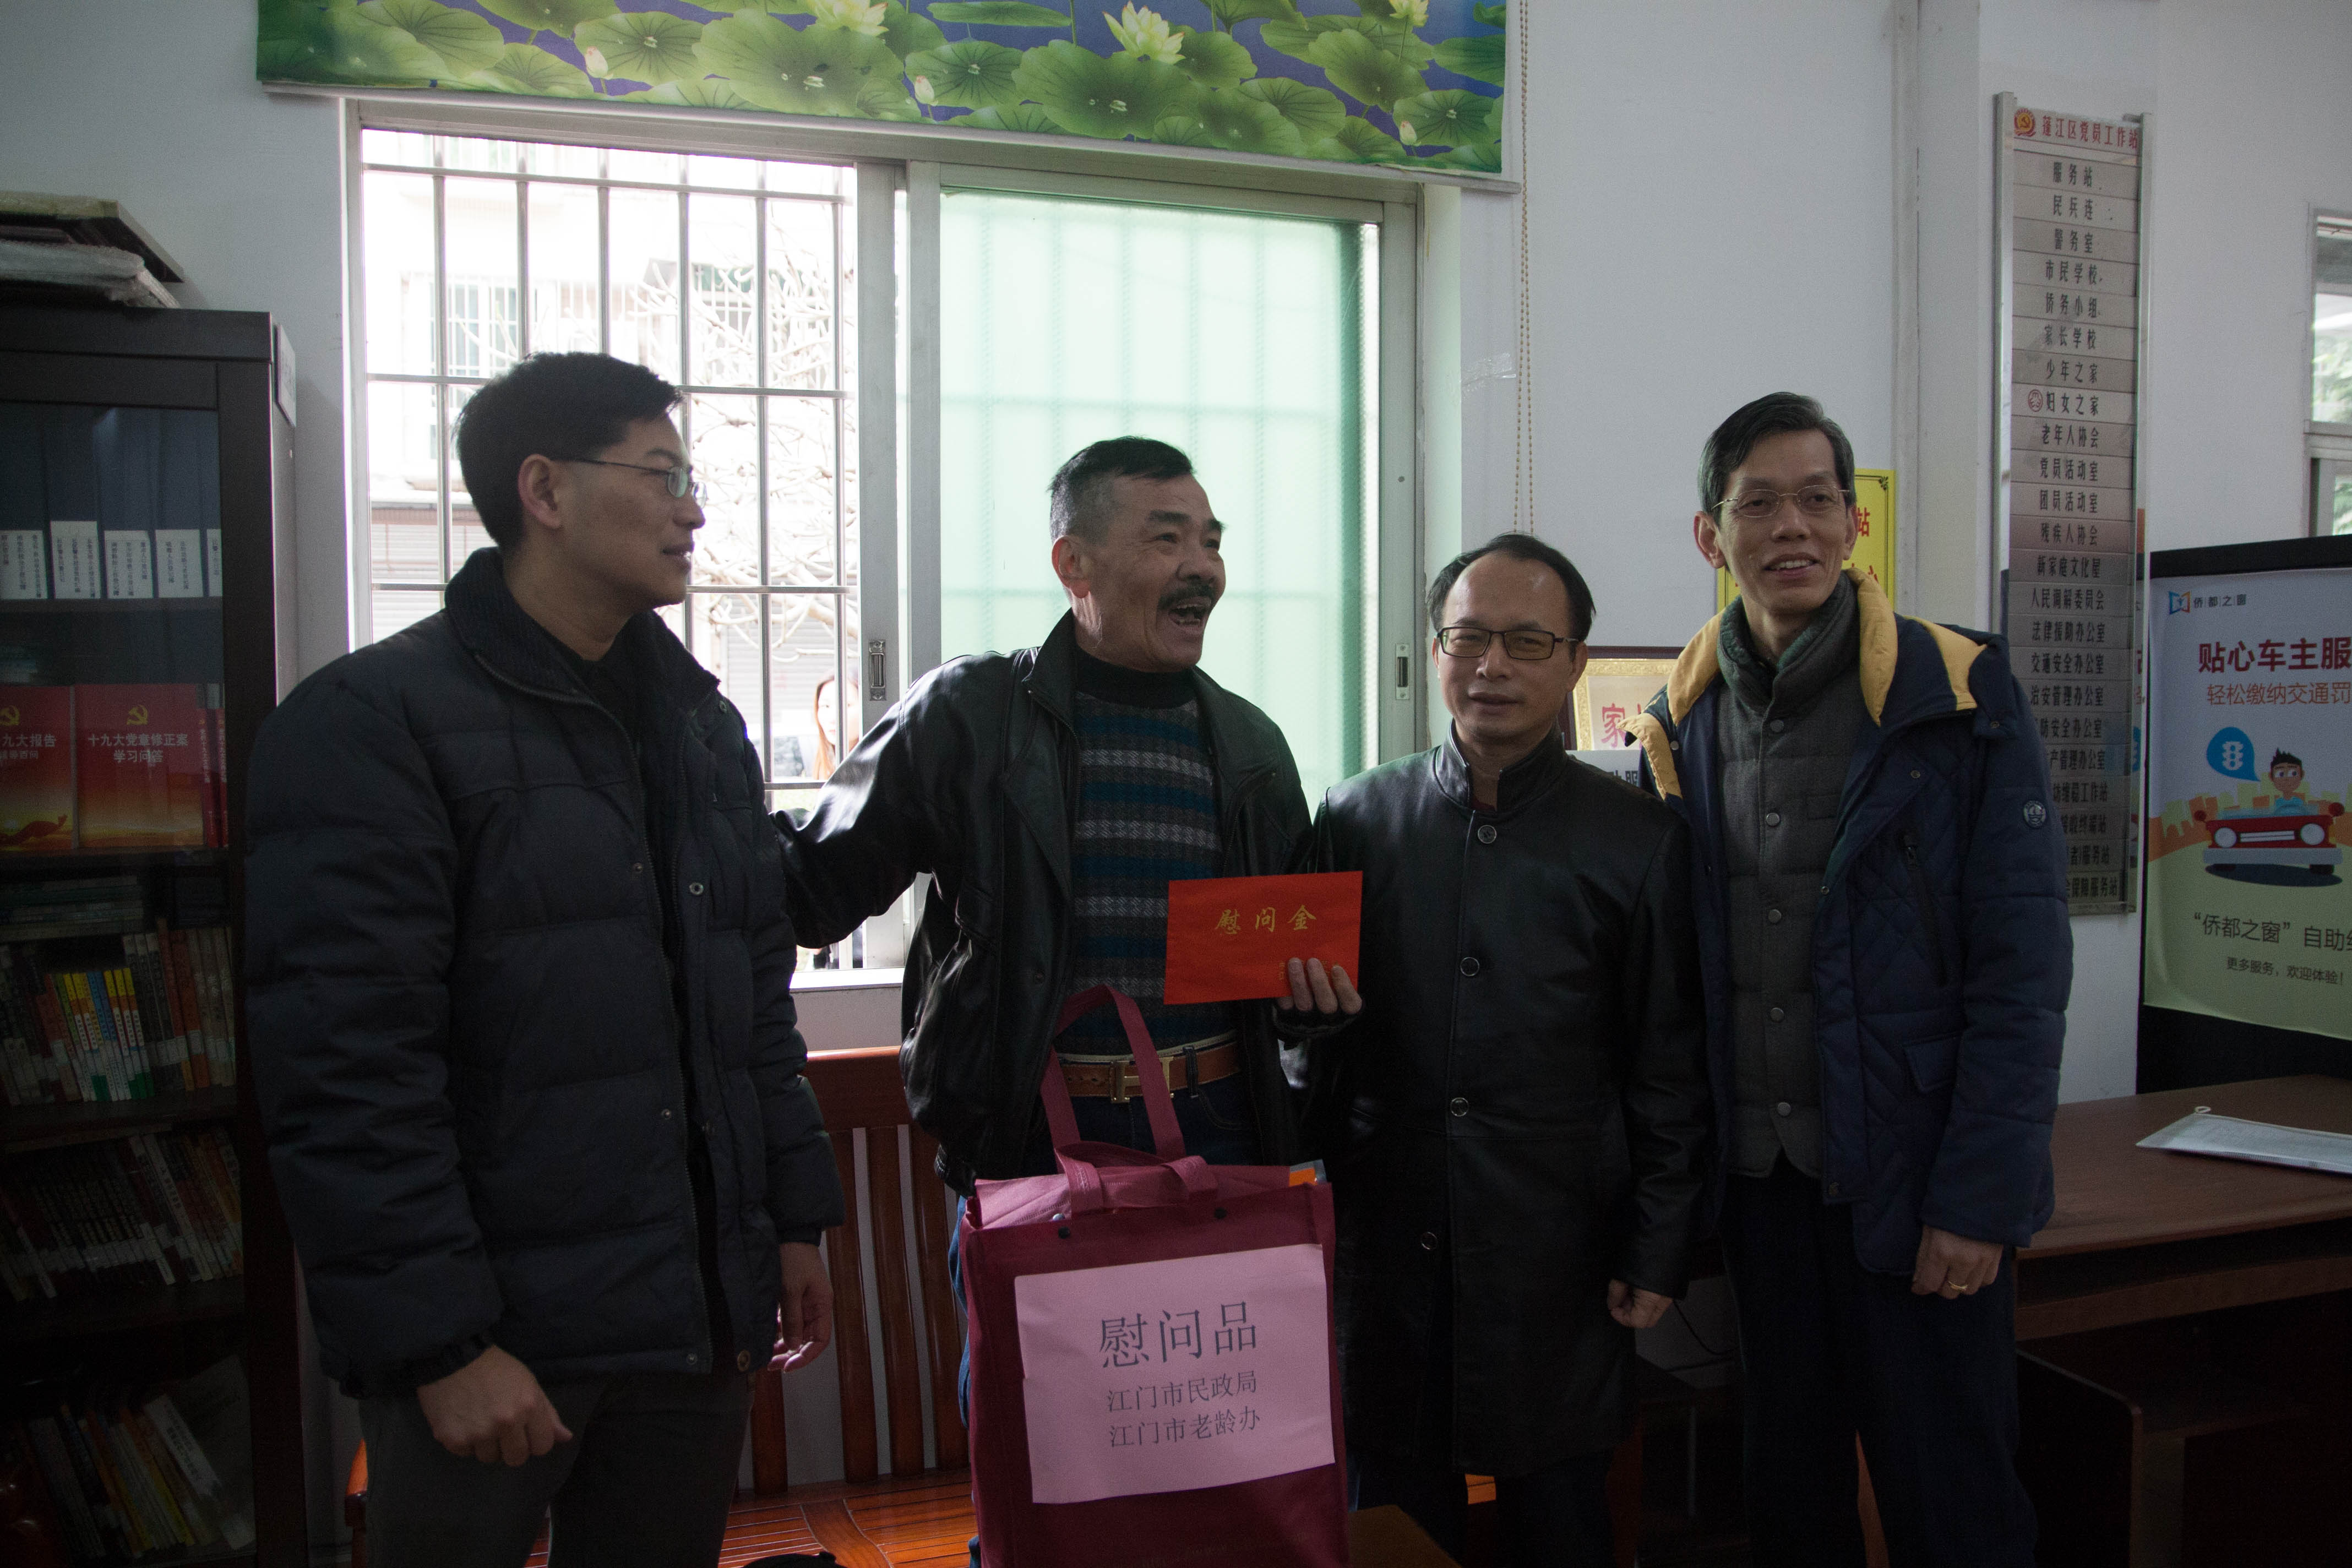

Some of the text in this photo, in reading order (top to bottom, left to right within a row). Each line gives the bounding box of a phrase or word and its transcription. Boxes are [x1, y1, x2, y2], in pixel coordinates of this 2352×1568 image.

[2041, 115, 2138, 150] 蓬江区党员工作站
[2052, 161, 2093, 188] 服务站
[2052, 194, 2093, 220] 民兵连
[2054, 228, 2093, 253] 警务室
[2045, 259, 2098, 285] 市民学校
[2045, 291, 2098, 319] 侨务小组
[2044, 325, 2097, 350] 家长学校
[2046, 358, 2098, 384] 少年之家
[2046, 391, 2099, 416] 妇女之家
[2041, 425, 2099, 449] 老年人协会
[2040, 457, 2098, 482] 党员活动室
[2039, 489, 2098, 514] 团员活动室
[2040, 522, 2098, 546] 残疾人协会
[2037, 556, 2101, 578] 新家庭文化屋
[2031, 587, 2104, 610] 人民调解委员会
[2032, 620, 2105, 643] 法律援助办公室
[2031, 652, 2104, 675] 交通安全办公室
[2198, 636, 2352, 673] 贴心车主服
[2030, 685, 2104, 706] 治安管理办公室
[2207, 681, 2352, 705] 轻松缴纳交通罚
[88, 733, 189, 748] 十九大党章修正案
[2035, 717, 2102, 739] 防安全办公室
[113, 749, 164, 764] 学习问答
[1215, 903, 1317, 935] 慰问金
[1099, 1300, 1257, 1369] 慰问品
[1106, 1370, 1257, 1412] 江门市民政局
[1109, 1405, 1261, 1448] 江门市老龄办
